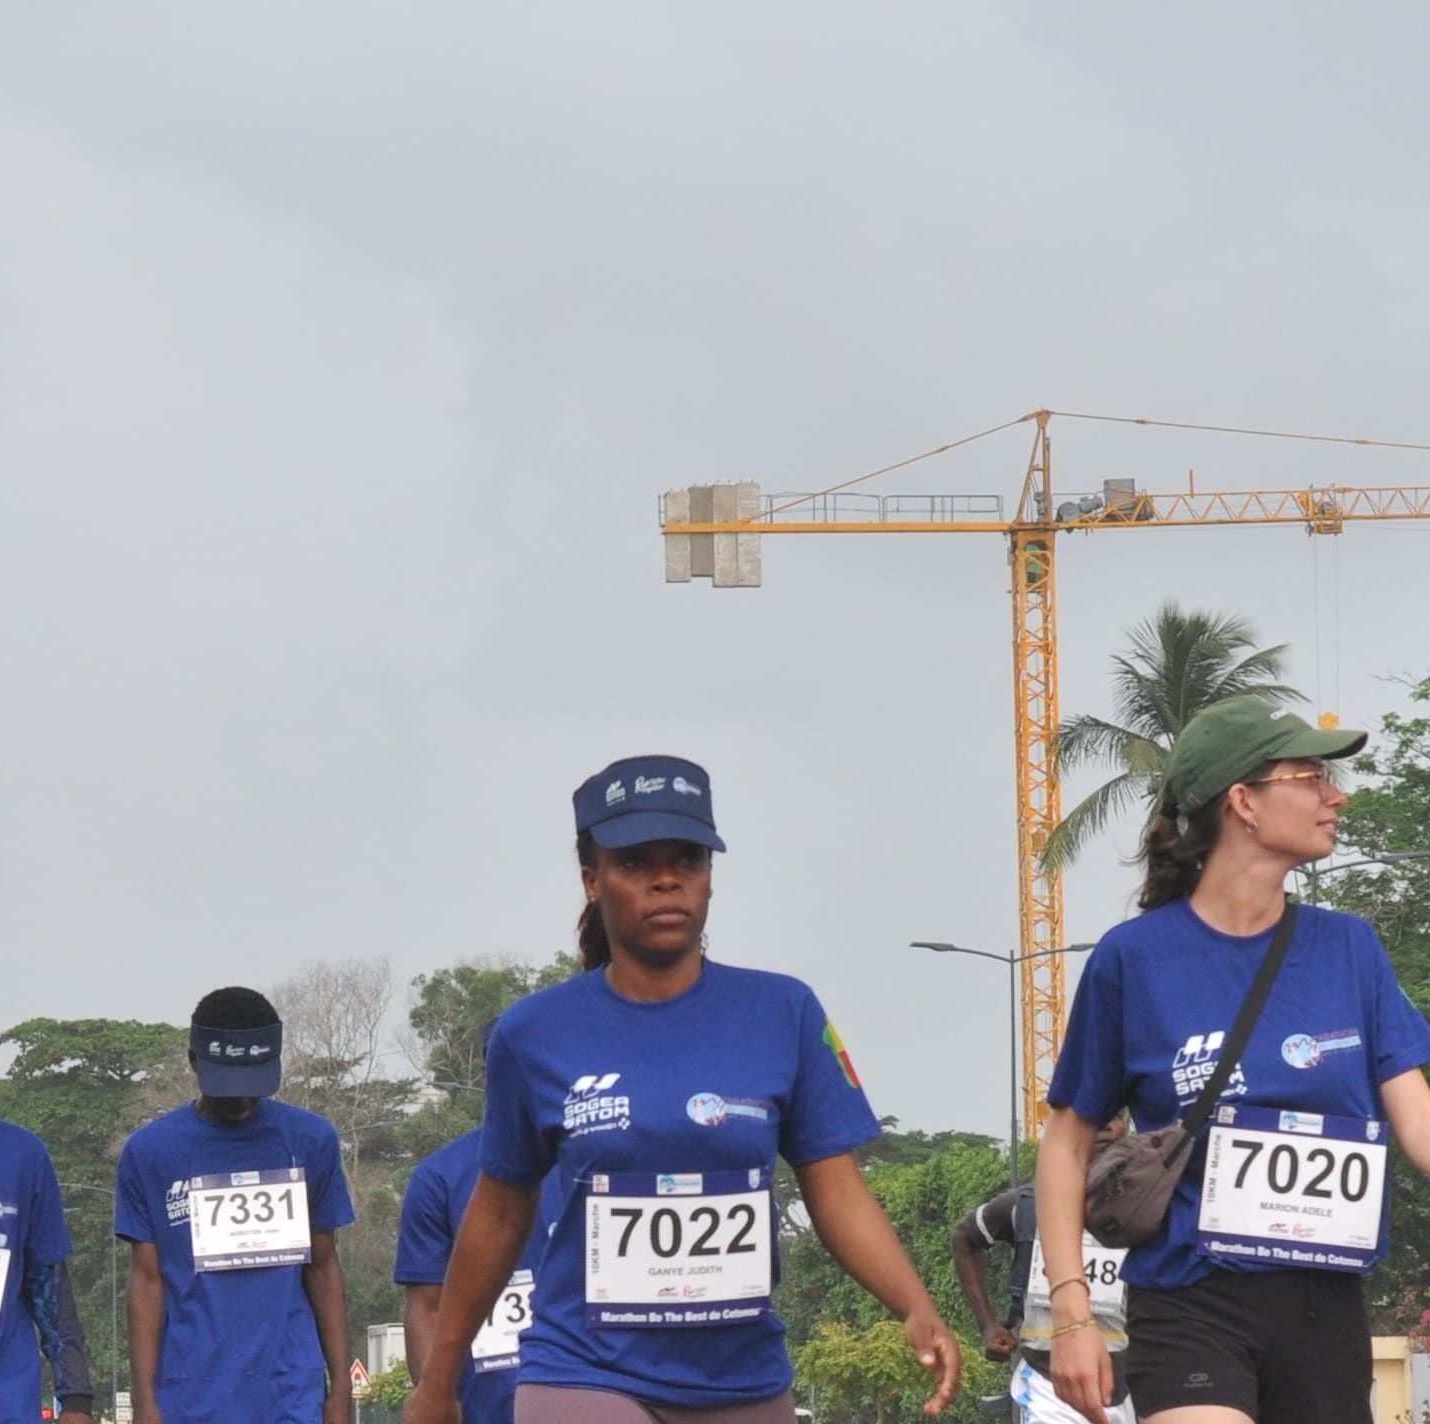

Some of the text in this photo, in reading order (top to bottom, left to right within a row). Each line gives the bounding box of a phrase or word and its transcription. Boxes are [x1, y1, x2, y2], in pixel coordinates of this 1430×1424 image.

[1175, 1070, 1246, 1096] SAM
[563, 1106, 630, 1129] SATOM
[564, 1096, 629, 1117] SOGEA
[1232, 1139, 1369, 1202] 7020
[204, 1188, 294, 1227] 7331
[591, 1203, 600, 1238] Marche
[1260, 1201, 1333, 1218] MARION ADELE
[610, 1203, 757, 1259] 7022
[591, 1247, 600, 1275] 10KM
[648, 1265, 723, 1276] GANYE JUDITH
[601, 1311, 647, 1323] Marathon
